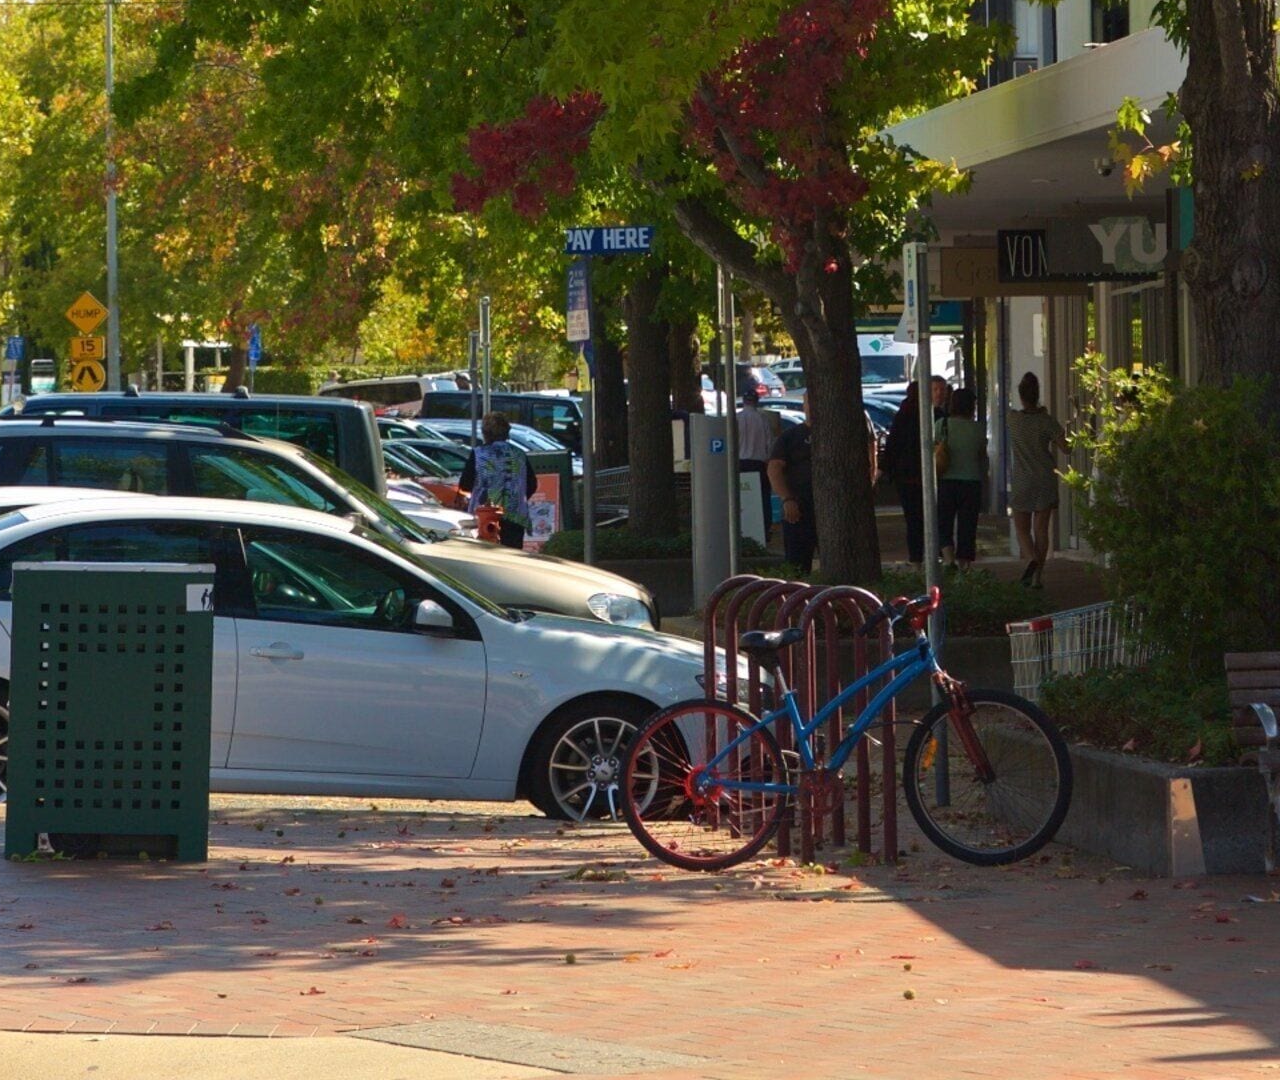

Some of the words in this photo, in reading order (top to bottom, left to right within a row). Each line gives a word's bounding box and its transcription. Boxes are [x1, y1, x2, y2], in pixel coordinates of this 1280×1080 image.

[564, 228, 594, 251] PAY
[602, 226, 650, 250] HERE
[71, 308, 101, 319] HUMP
[80, 340, 95, 353] 15
